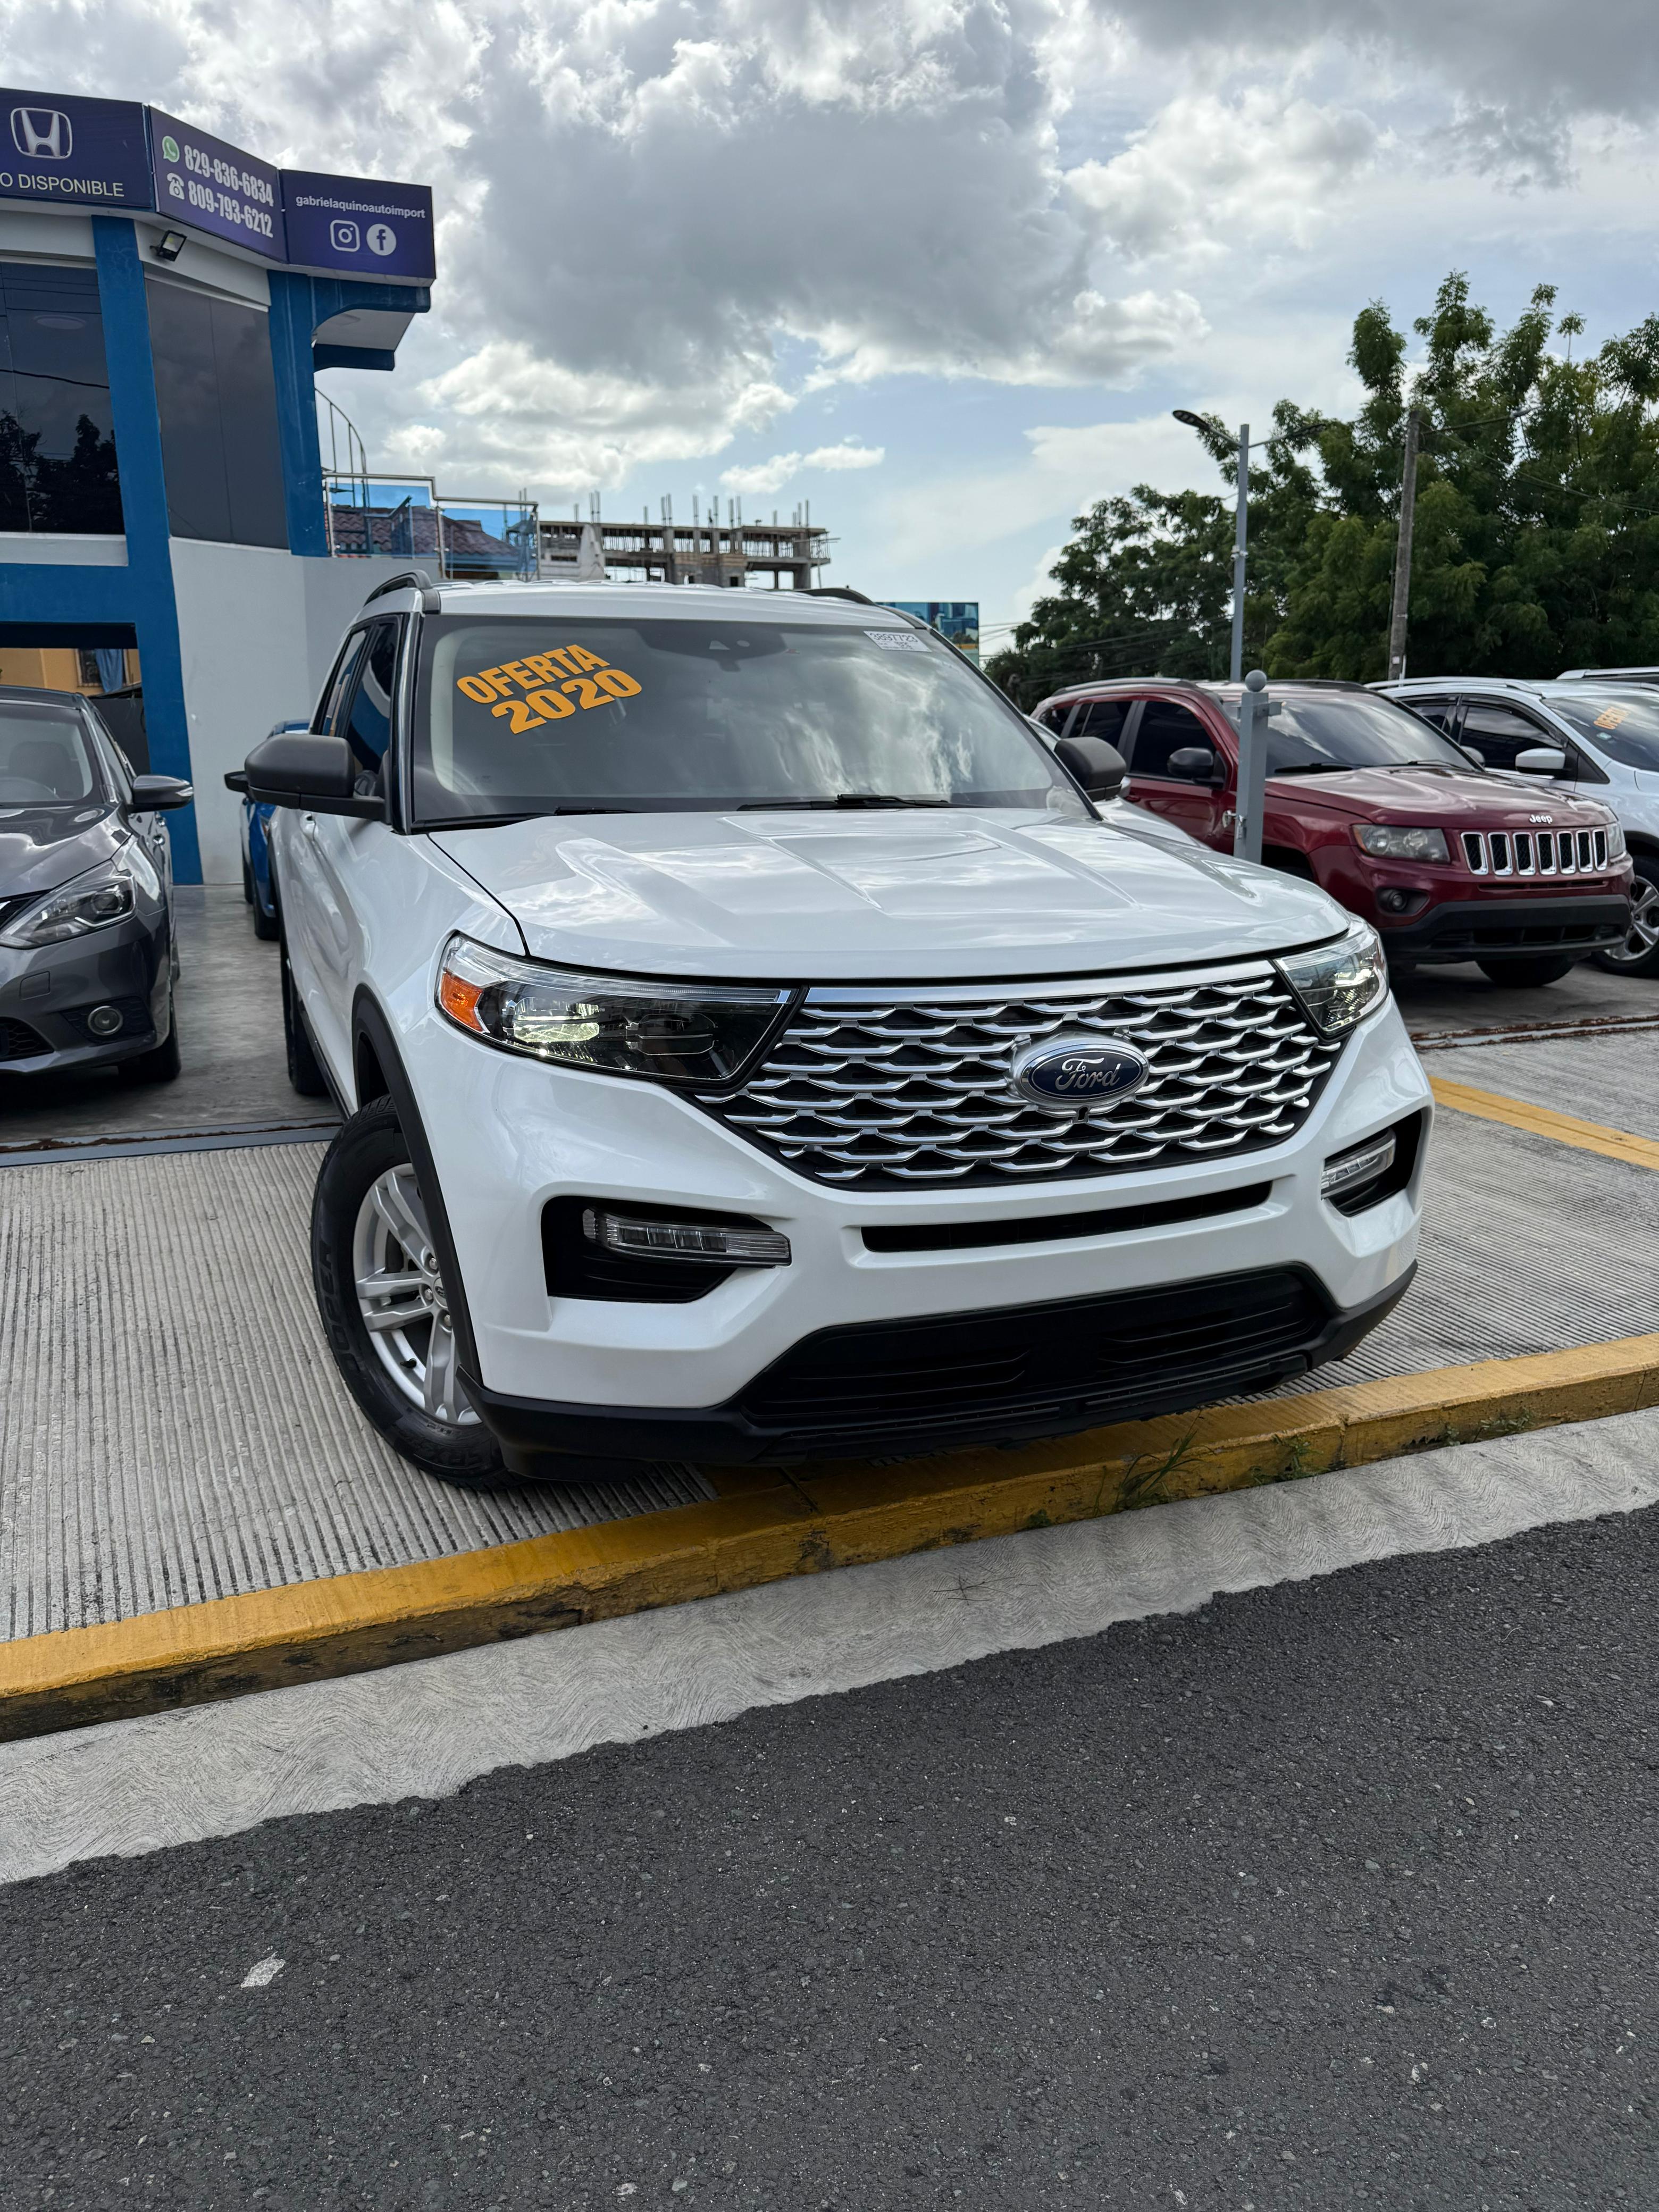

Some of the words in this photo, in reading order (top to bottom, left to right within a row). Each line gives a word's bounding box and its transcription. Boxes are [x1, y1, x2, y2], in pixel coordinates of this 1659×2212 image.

[18, 173, 124, 197] DISPONIBLE
[184, 145, 274, 207] 829-836-6834
[188, 180, 273, 238] 809-793-6212
[296, 196, 425, 219] gabrielaquinoautoimport
[456, 644, 610, 703] OFERTA
[491, 669, 642, 734] 2020
[1529, 814, 1553, 824] Jeep
[1055, 1057, 1120, 1091] Ford
